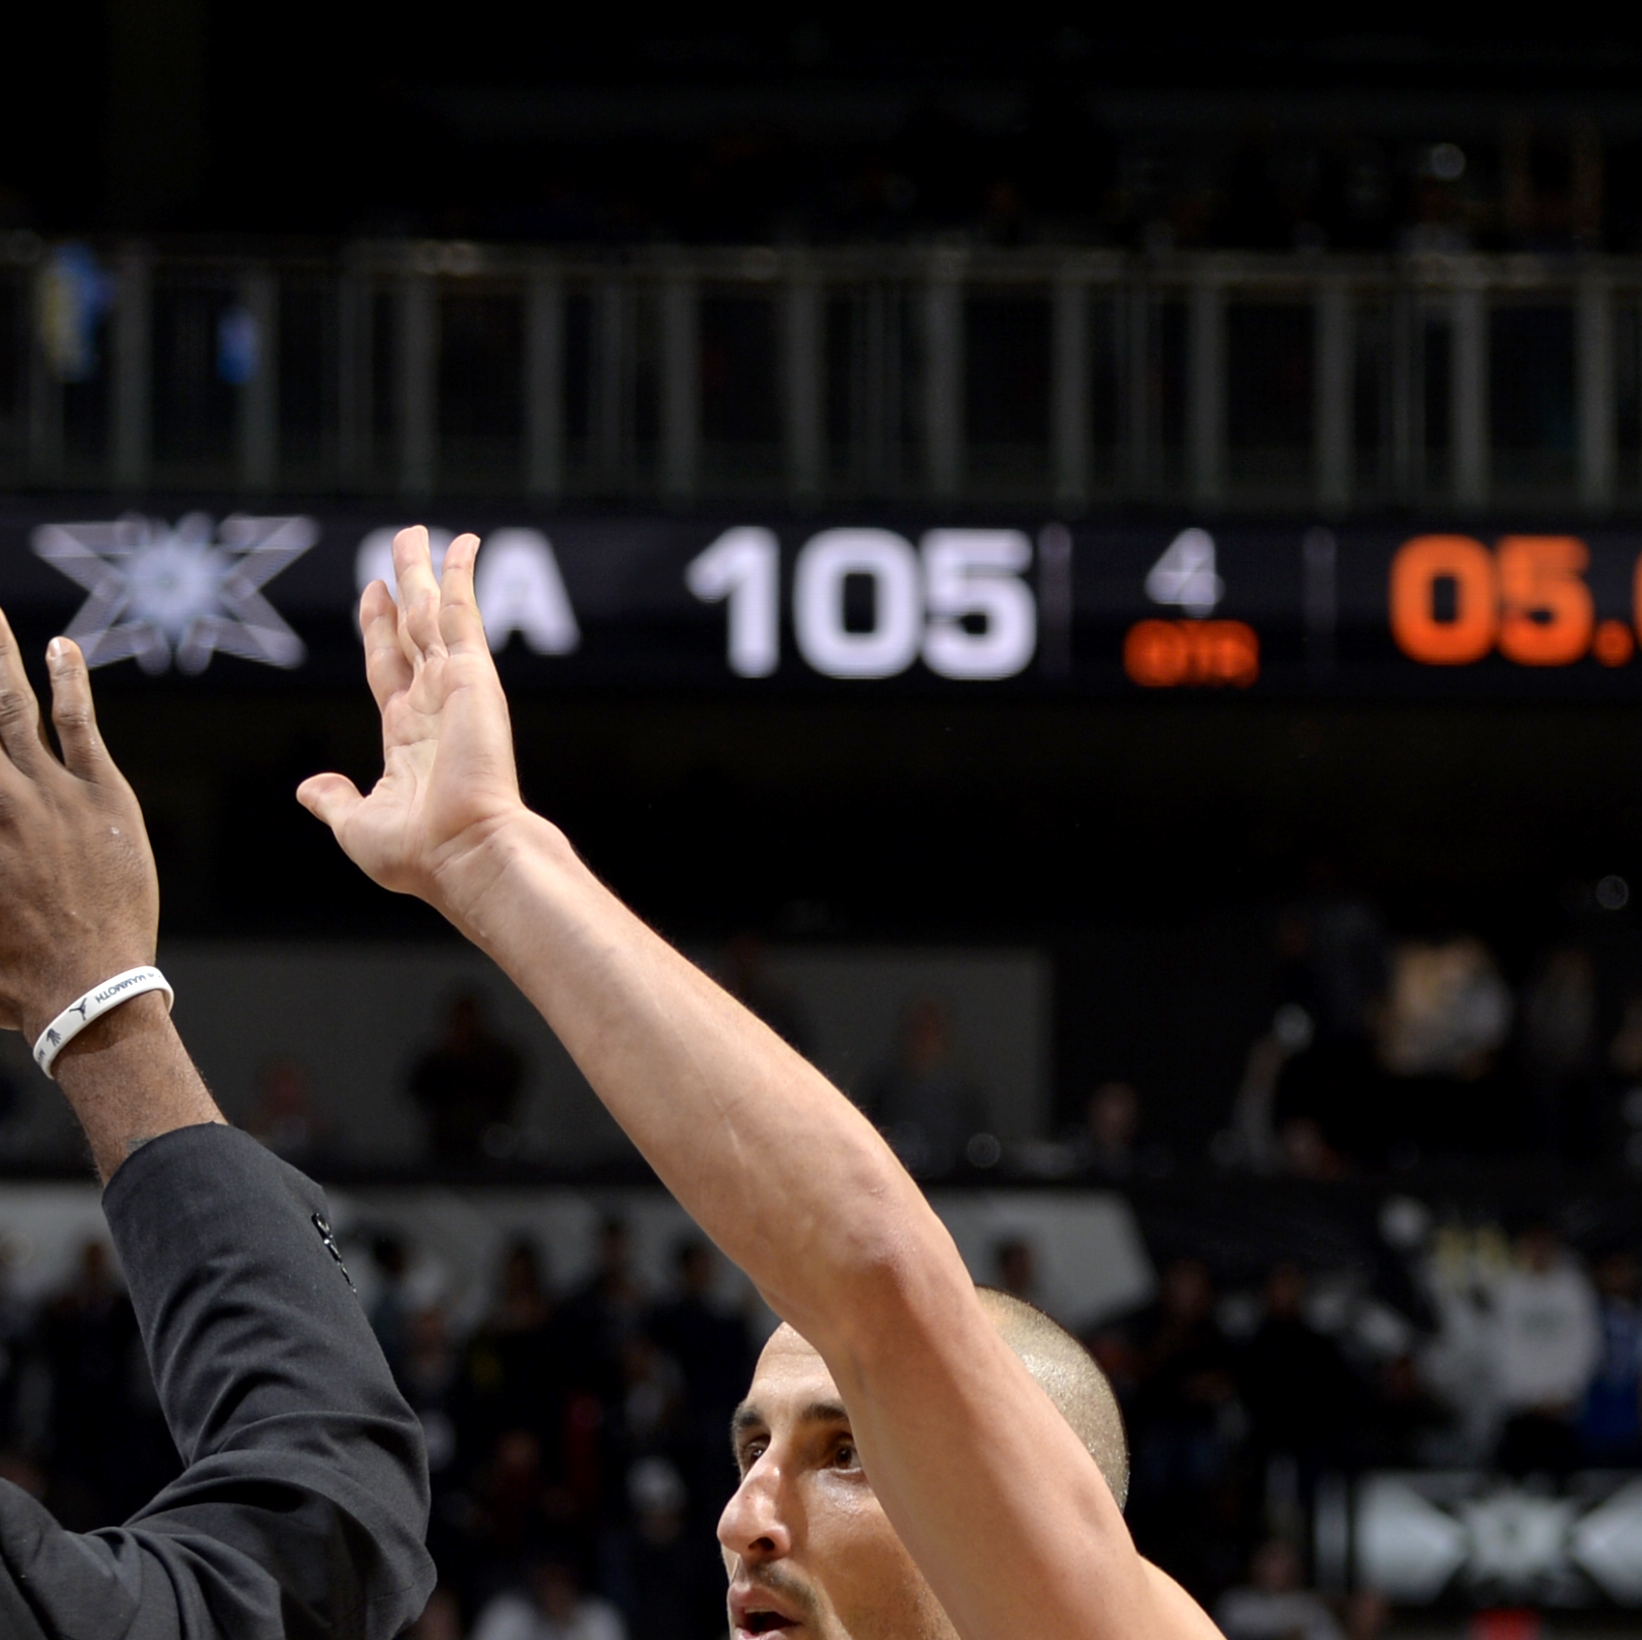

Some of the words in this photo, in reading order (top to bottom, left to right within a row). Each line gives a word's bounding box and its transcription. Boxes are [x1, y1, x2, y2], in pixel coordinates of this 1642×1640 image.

[686, 525, 1038, 680] 105
[1145, 527, 1225, 618] 4
[95, 974, 146, 1003] MAMMOTH
